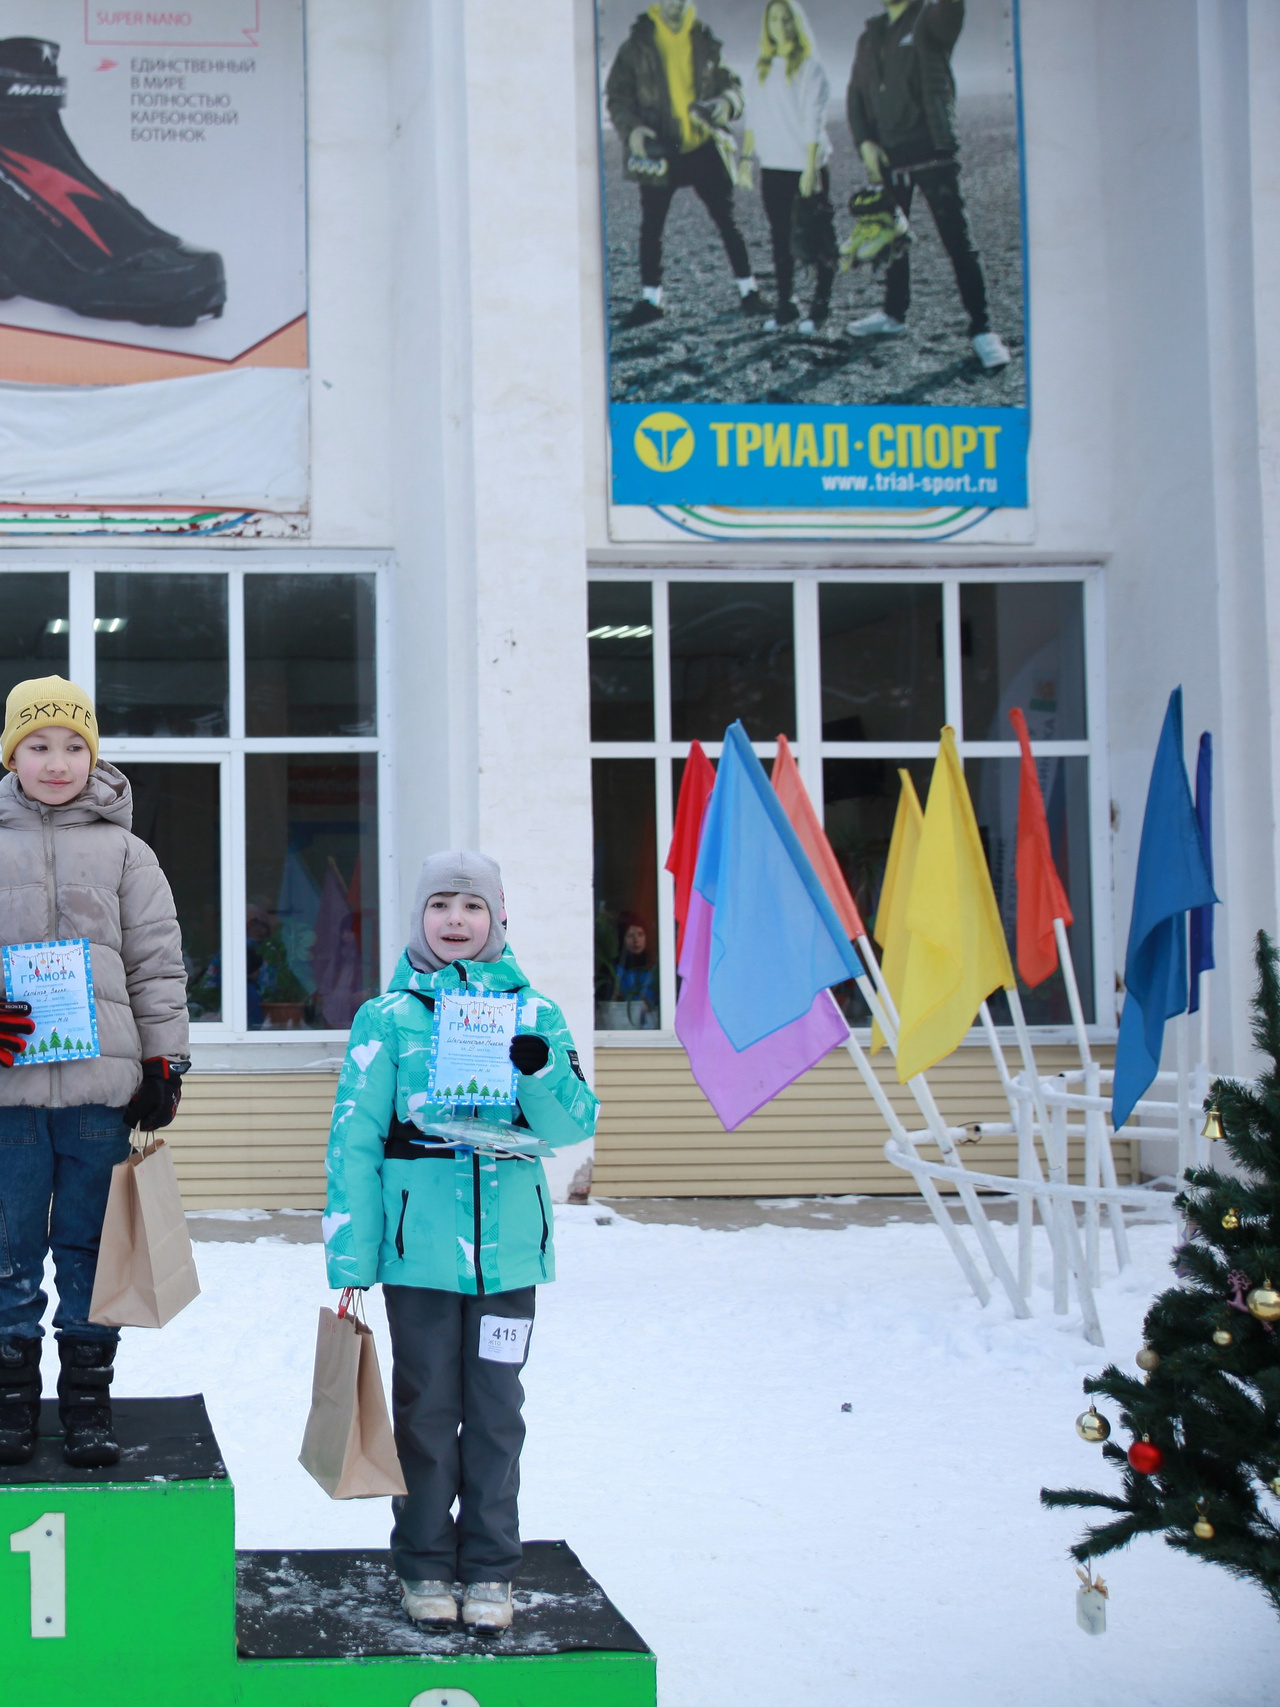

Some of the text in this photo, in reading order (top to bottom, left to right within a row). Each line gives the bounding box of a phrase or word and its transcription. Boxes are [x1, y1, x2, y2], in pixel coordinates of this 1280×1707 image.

[96, 11, 193, 27] SUPER NANO
[130, 56, 257, 74] ЕДИНСТВЕННЫЙ
[130, 76, 187, 91] В МИРЕ
[130, 93, 232, 108] ПОЛНОСТЬЮ
[130, 110, 240, 126] КАРБОНОВЫЙ
[130, 128, 207, 143] БОТИНОК
[821, 471, 998, 496] www.trial-sport.ru
[20, 970, 76, 984] ГРАМОТА
[448, 1021, 505, 1034] ГРАМОТА
[492, 1326, 517, 1342] 415
[9, 1512, 66, 1638] 1
